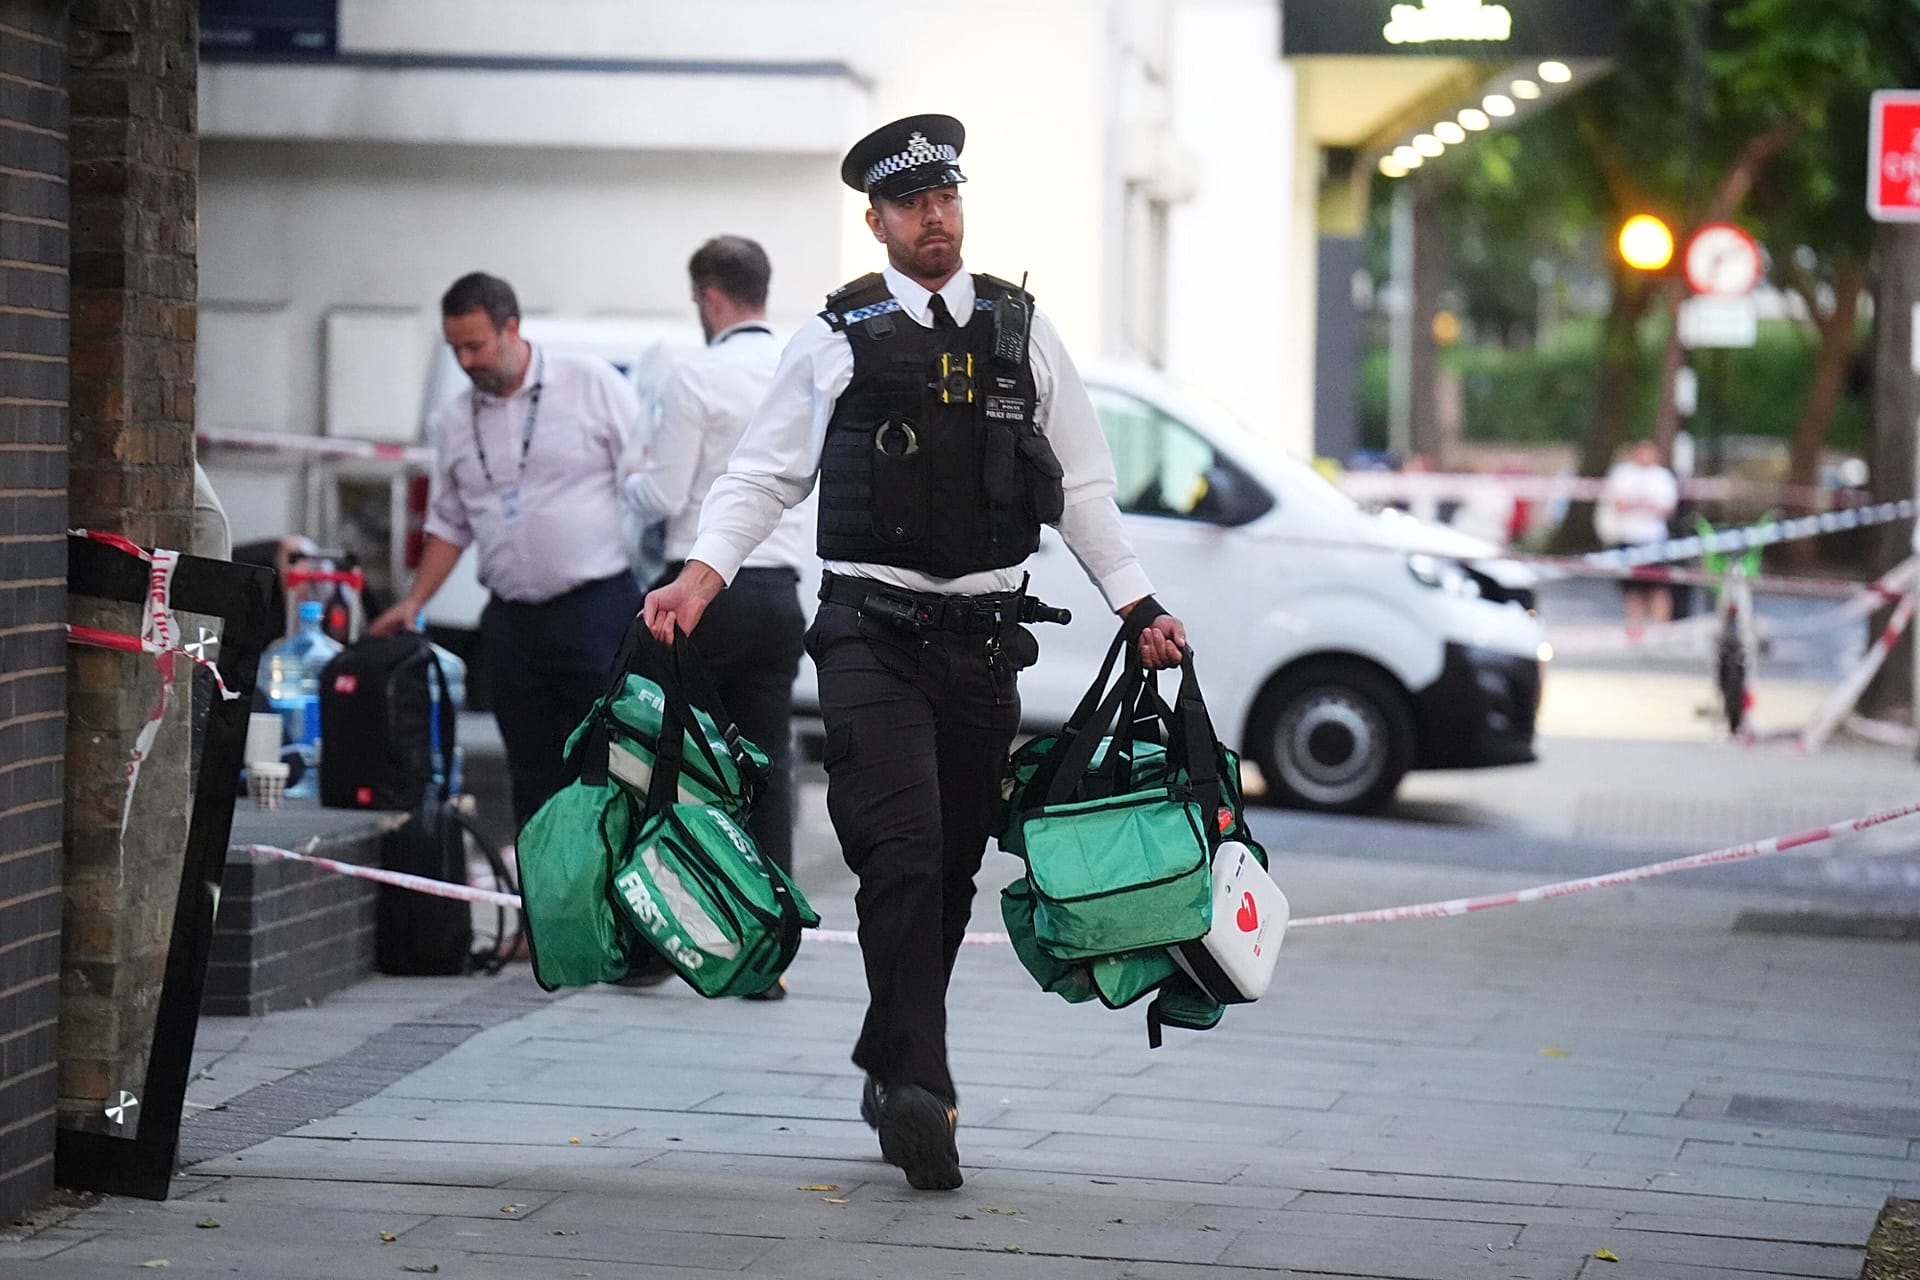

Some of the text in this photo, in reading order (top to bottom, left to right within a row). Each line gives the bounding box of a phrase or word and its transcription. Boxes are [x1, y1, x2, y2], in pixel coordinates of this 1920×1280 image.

[986, 410, 1005, 419] POLICE
[707, 809, 762, 863] FIRST
[619, 871, 669, 934] FIRST
